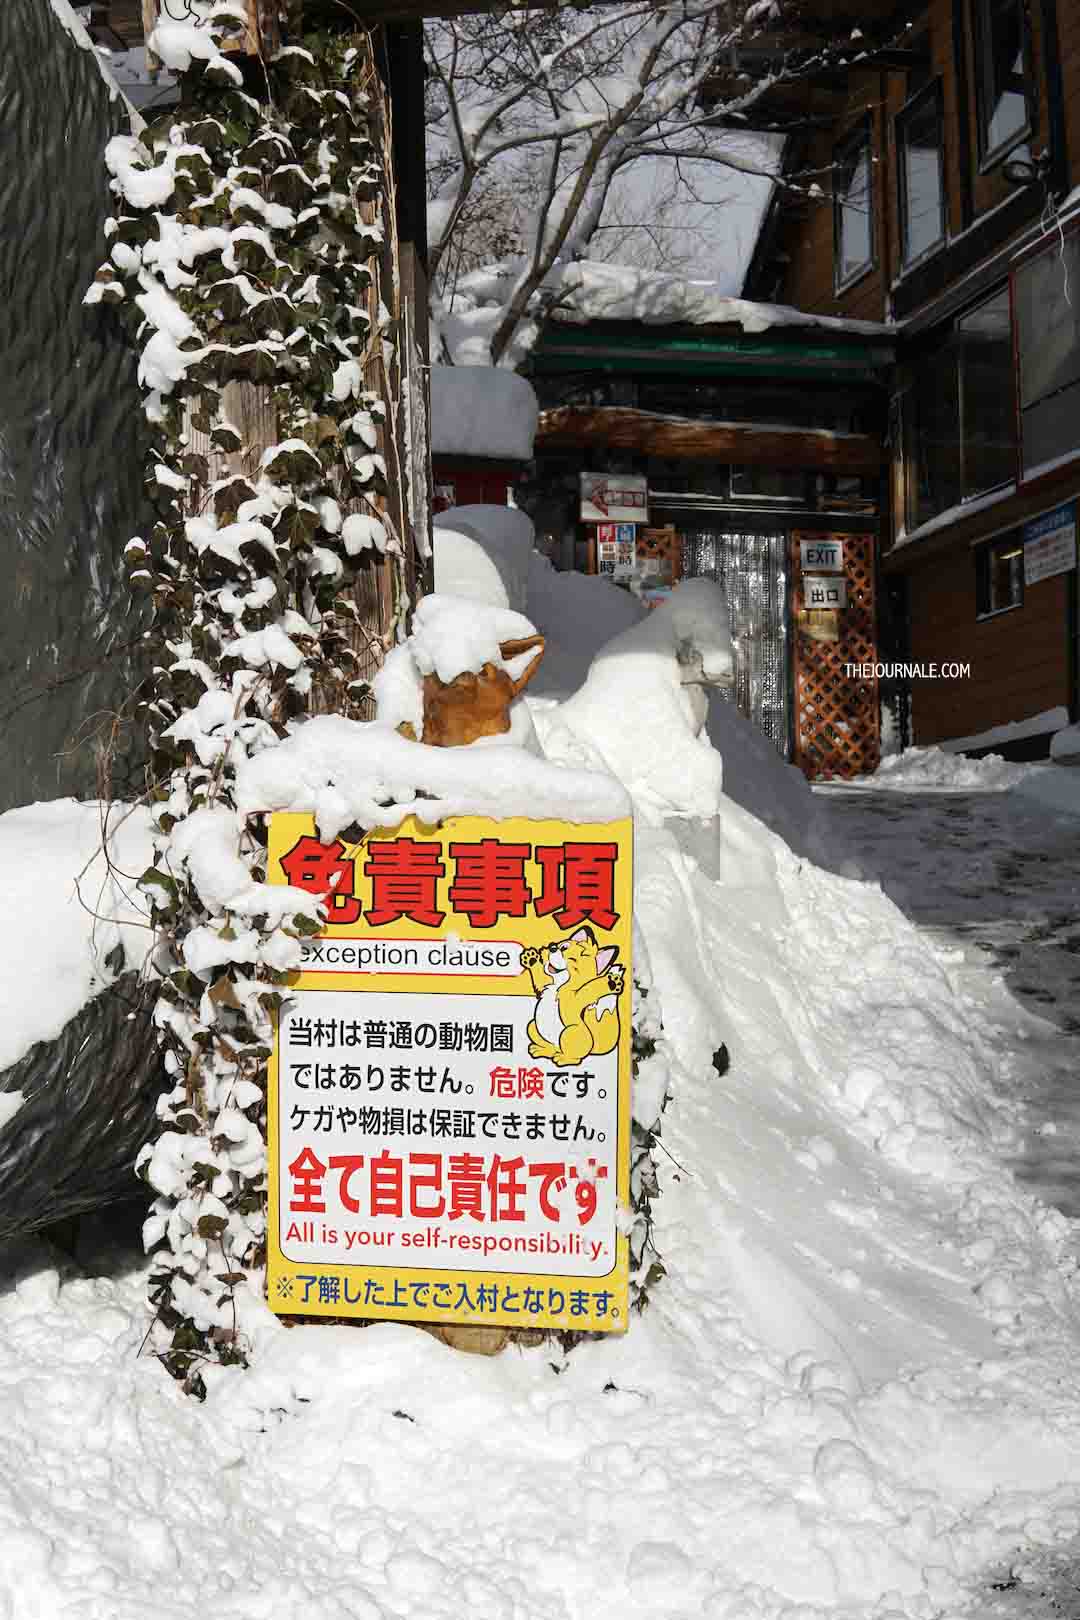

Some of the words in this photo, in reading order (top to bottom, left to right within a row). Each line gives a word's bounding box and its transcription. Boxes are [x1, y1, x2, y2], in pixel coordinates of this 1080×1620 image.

[807, 549, 838, 565] EXIT
[812, 589, 838, 603] 出口
[279, 835, 620, 931] 免責事項
[427, 946, 511, 968] clause
[288, 1017, 514, 1053] 当村は普通の動物園
[289, 1105, 606, 1142] ケガや物損は保証できません。
[288, 1147, 608, 1226] 全て自己責任です
[286, 1223, 314, 1243] All
[322, 1226, 338, 1244] is
[344, 1228, 395, 1251] your
[401, 1228, 608, 1262] self-responsibiliy.
